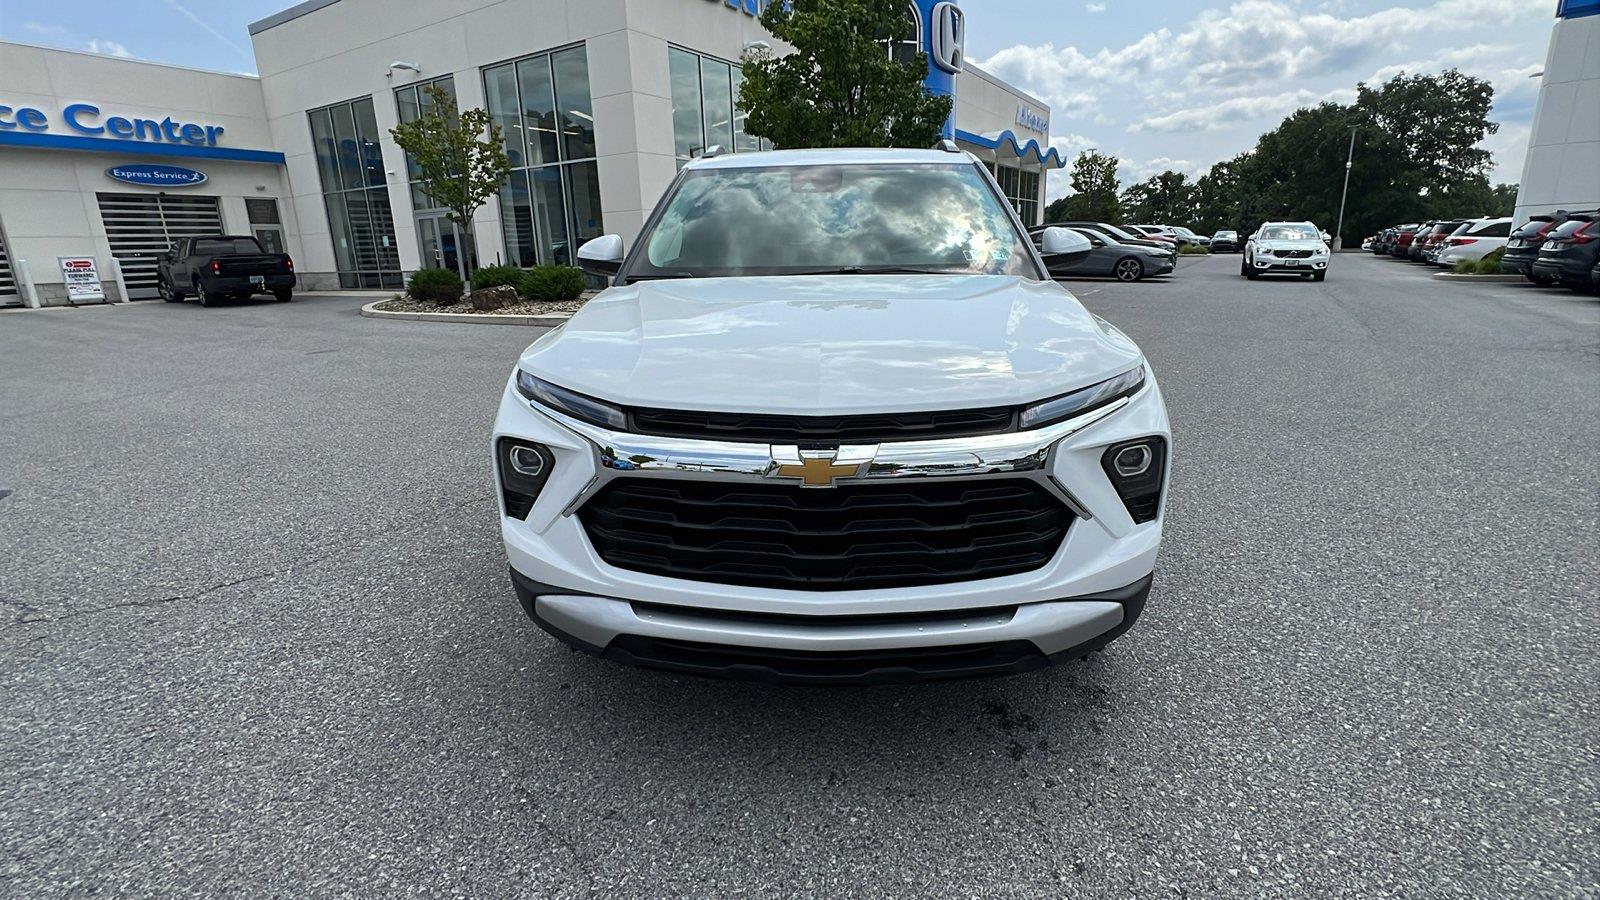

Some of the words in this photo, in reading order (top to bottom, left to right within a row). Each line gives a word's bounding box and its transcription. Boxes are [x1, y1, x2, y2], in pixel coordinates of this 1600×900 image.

[63, 104, 225, 146] Center
[113, 169, 152, 179] Express
[154, 171, 188, 180] Service
